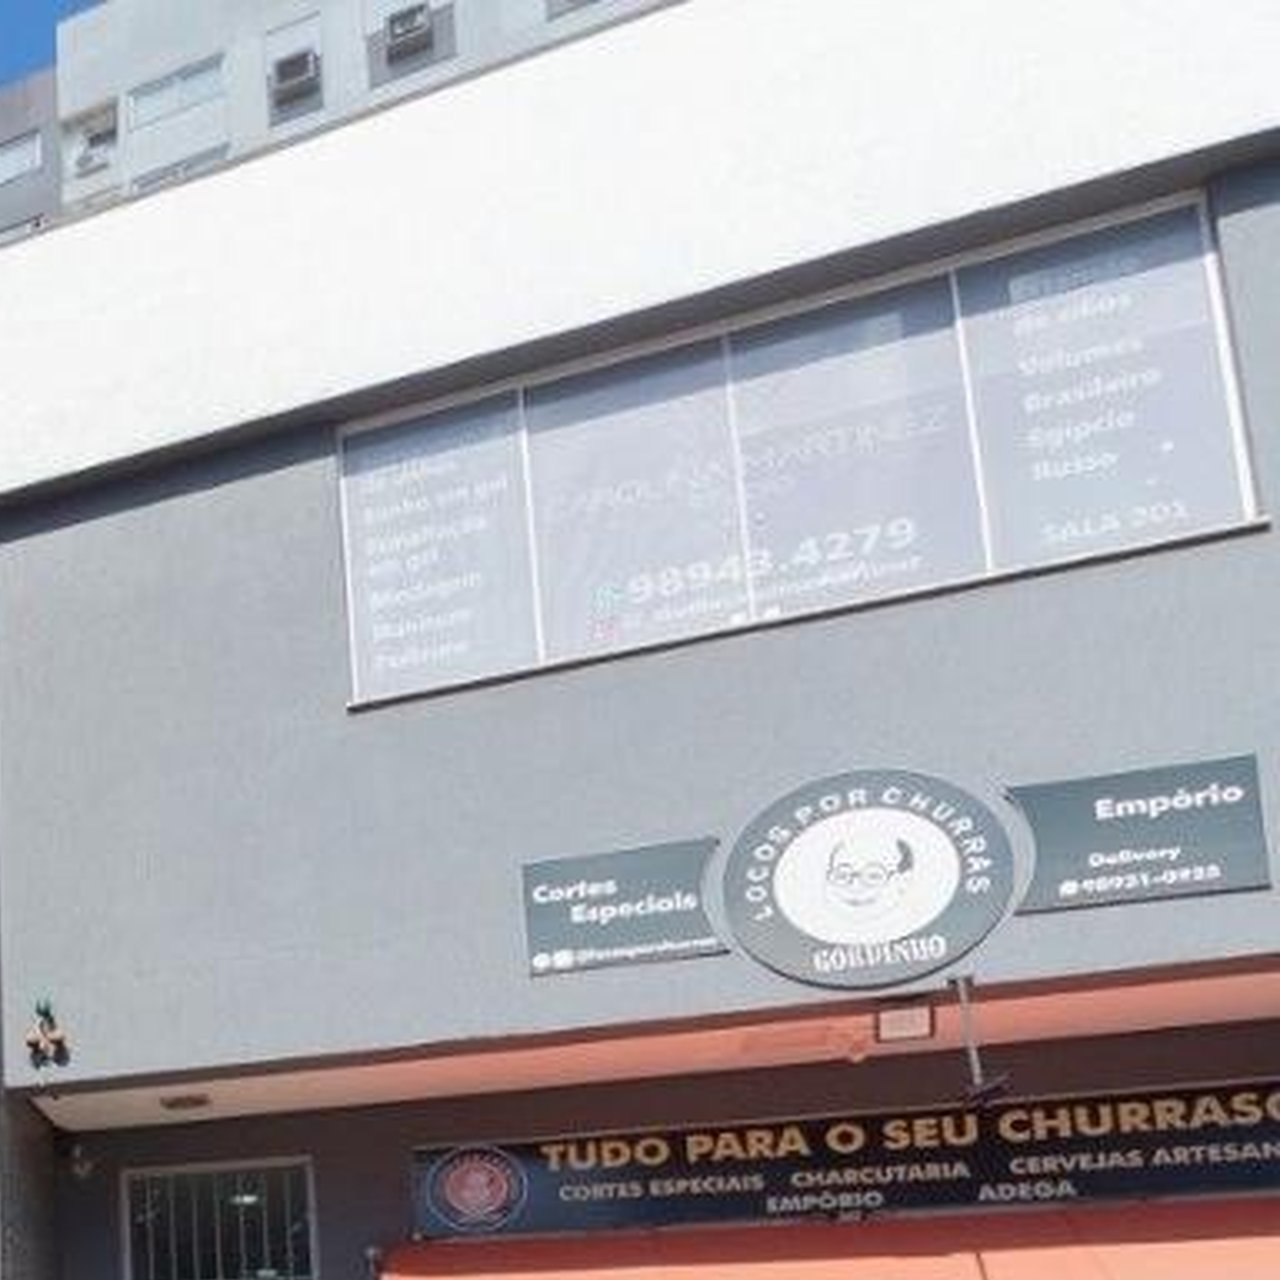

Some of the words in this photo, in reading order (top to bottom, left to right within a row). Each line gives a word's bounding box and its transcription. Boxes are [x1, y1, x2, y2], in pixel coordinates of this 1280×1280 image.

[1093, 784, 1246, 822] Empório
[744, 825, 791, 922] LOCOS
[794, 788, 868, 825] POR
[881, 785, 992, 896] CHURRAS
[532, 879, 618, 904] Cortes
[569, 889, 699, 926] Especiais
[812, 934, 947, 973] GORDINHO
[540, 1137, 670, 1173] TUDO
[685, 1126, 813, 1165] PARA
[824, 1122, 866, 1155] O
[881, 1112, 979, 1150] SEU
[791, 1160, 972, 1189] CHARCUTARIA
[1008, 1150, 1144, 1177] CERVEJAS
[558, 1180, 643, 1202] CORTES
[648, 1173, 765, 1196] ESPECIAIS
[766, 1188, 885, 1213] EMPÓRIO
[977, 1178, 1079, 1203] ADEGA
